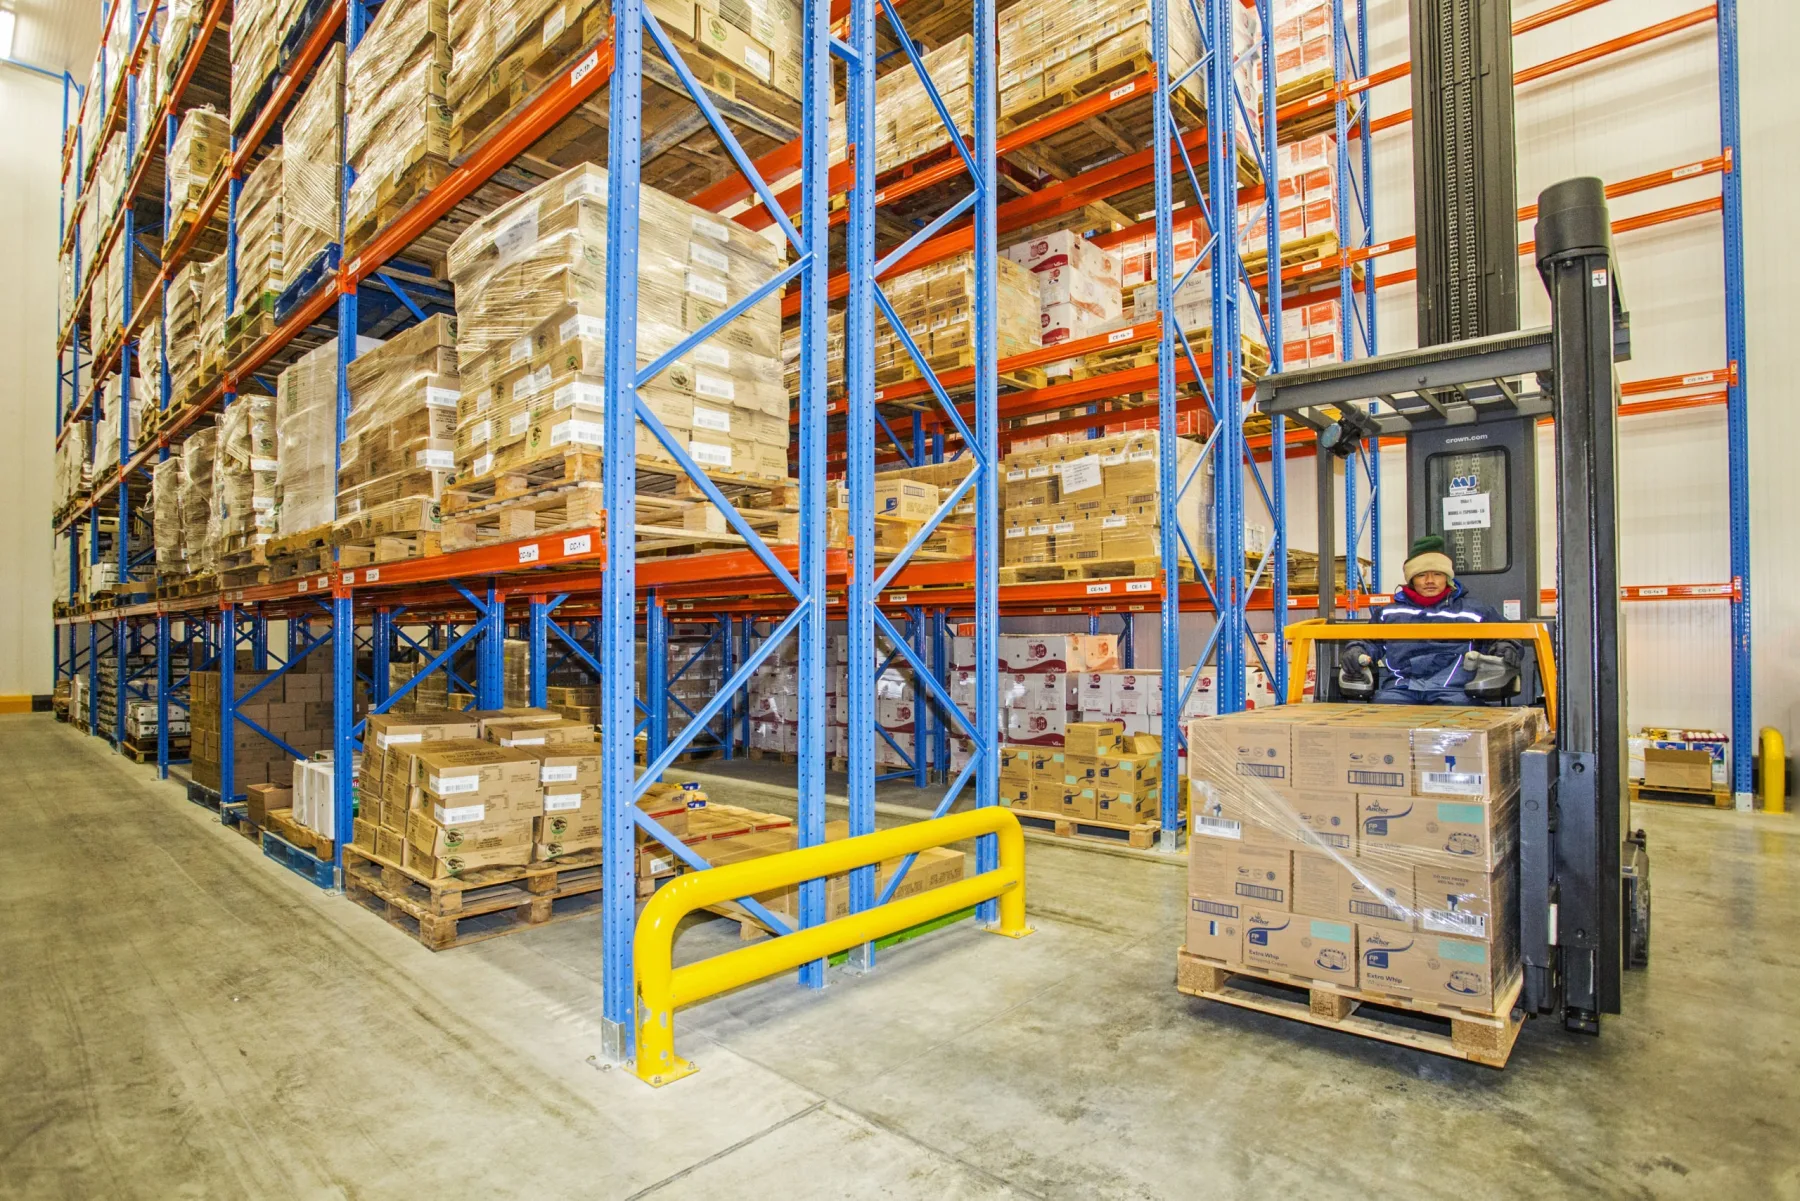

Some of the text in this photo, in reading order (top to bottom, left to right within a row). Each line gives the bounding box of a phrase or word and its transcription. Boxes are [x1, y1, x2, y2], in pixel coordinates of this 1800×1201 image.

[1445, 434, 1488, 444] crown.com
[1365, 804, 1389, 814] Anchor
[1249, 916, 1270, 925] Anchor
[1366, 937, 1390, 946] Anchor
[1248, 949, 1280, 960] Extra Whip
[1366, 972, 1403, 984] Extra Whip
